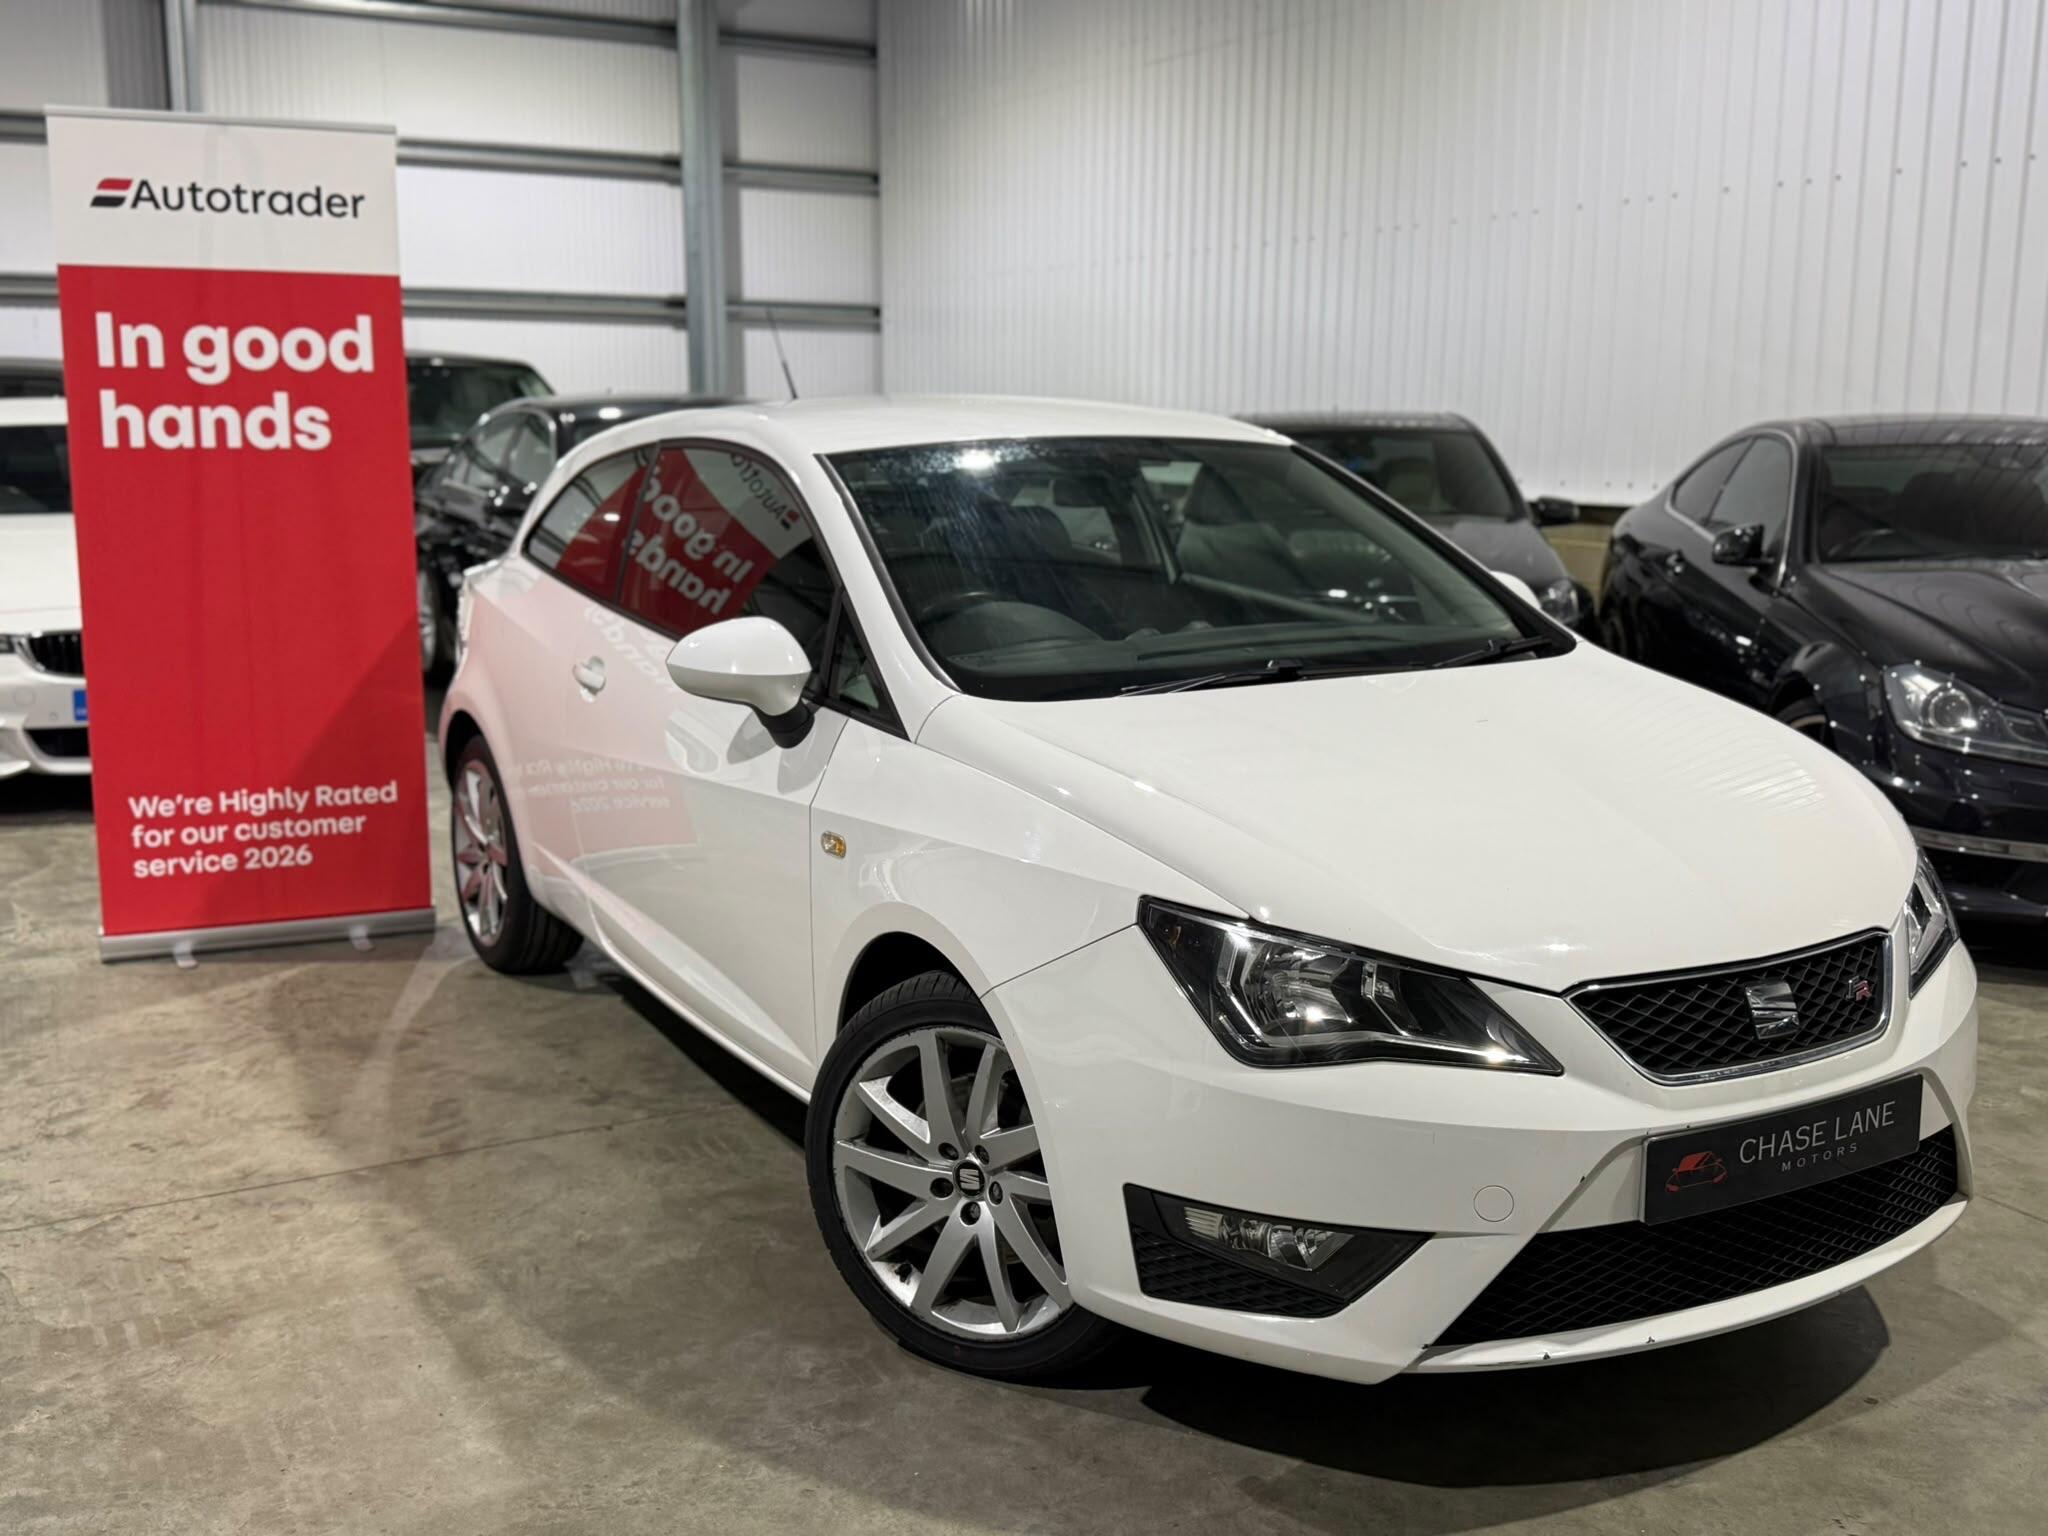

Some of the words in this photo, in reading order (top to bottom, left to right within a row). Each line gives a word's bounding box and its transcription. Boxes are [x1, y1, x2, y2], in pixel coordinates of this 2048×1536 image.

[131, 179, 366, 218] Autotrader
[95, 312, 165, 368] In
[183, 314, 374, 385] good
[100, 389, 332, 451] hands
[128, 793, 213, 818] We’re
[219, 786, 310, 817] Highly
[315, 780, 398, 807] Rated
[132, 824, 175, 848] for
[180, 825, 228, 845] our
[234, 815, 367, 841] customer
[133, 850, 238, 878] service
[244, 844, 313, 870] 2026
[1739, 1120, 1827, 1164] CHASE
[1835, 1101, 1895, 1141] LANE
[1781, 1143, 1857, 1172] MOTORS
